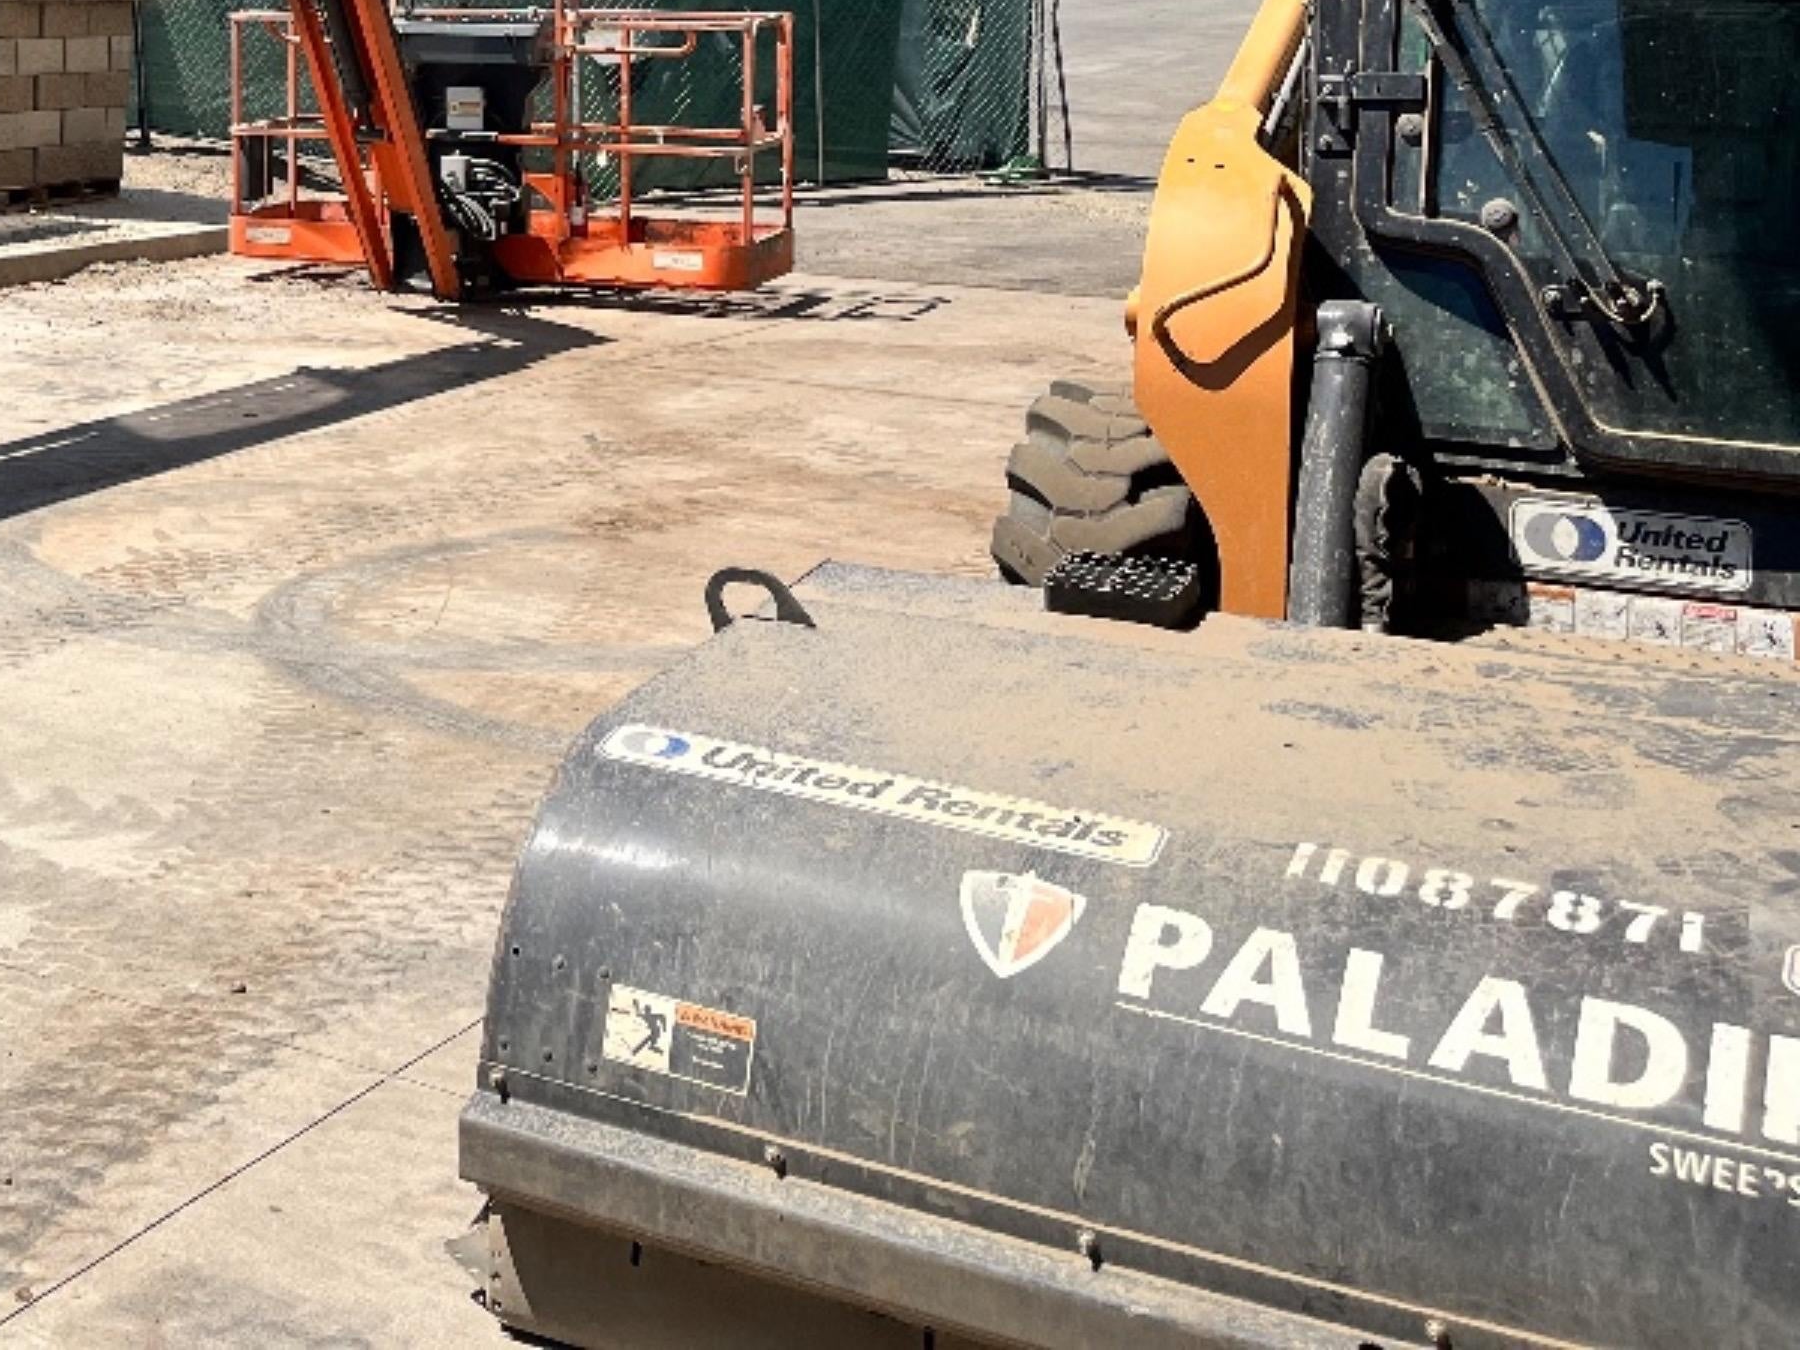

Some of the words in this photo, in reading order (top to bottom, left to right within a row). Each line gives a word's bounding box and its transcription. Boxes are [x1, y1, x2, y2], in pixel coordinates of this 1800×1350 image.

[1613, 546, 1738, 579] Rentals
[1617, 521, 1729, 553] United
[701, 746, 895, 799] United
[897, 785, 1129, 847] Rentals
[1286, 842, 1705, 953] 11087871
